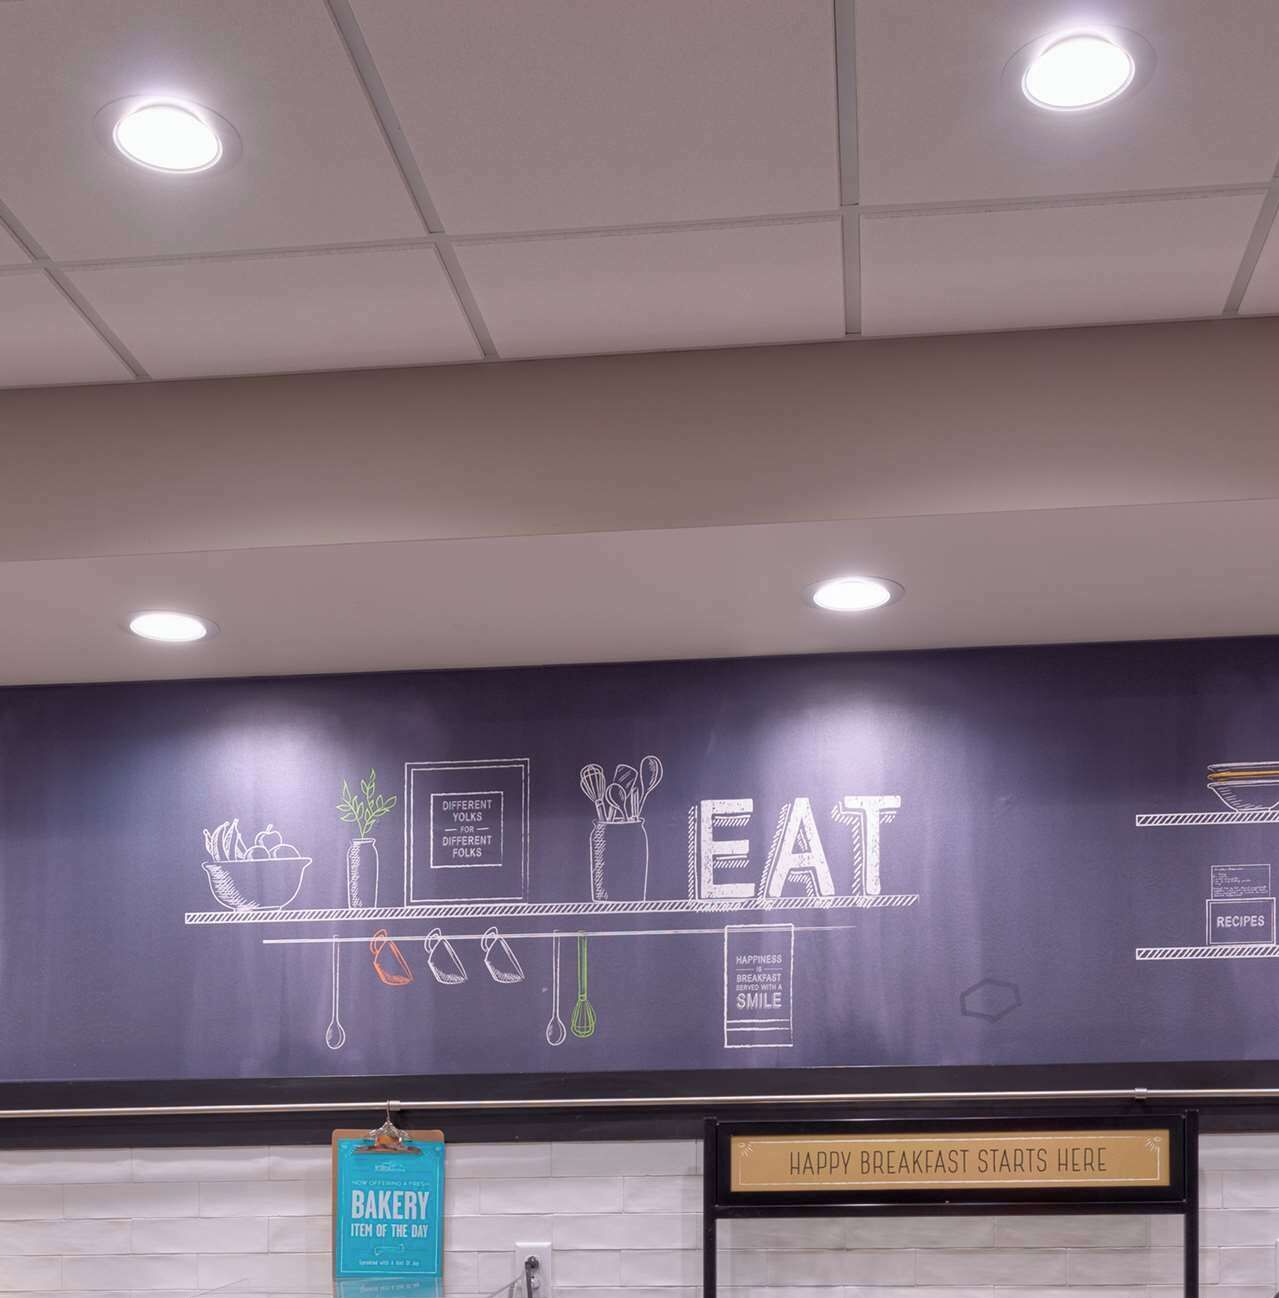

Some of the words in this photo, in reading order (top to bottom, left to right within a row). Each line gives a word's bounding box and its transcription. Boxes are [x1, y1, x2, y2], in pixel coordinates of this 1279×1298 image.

[442, 799, 493, 811] DIFFERENT
[452, 811, 483, 822] YOLKS
[460, 825, 475, 835] FOR
[442, 835, 493, 847] DIFFERENT
[452, 847, 483, 859] FOLKS
[692, 795, 902, 900] EAT
[1216, 914, 1265, 928] RECIPES
[736, 954, 783, 965] HAPPINESS
[736, 973, 782, 983] BREAKFAST
[736, 983, 760, 991] SERVED
[761, 983, 778, 991] WITH
[778, 983, 783, 991] A
[736, 992, 783, 1010] SMILE
[789, 1151, 852, 1175] HAPPY
[860, 1149, 969, 1175] BREAKFAST
[977, 1147, 1048, 1174] STARTS
[1057, 1147, 1107, 1172] HERE
[351, 1189, 430, 1220] BAKERY
[350, 1223, 373, 1238] ITEM
[375, 1223, 387, 1238] OF
[391, 1223, 409, 1238] THE
[410, 1223, 428, 1238] DAY
